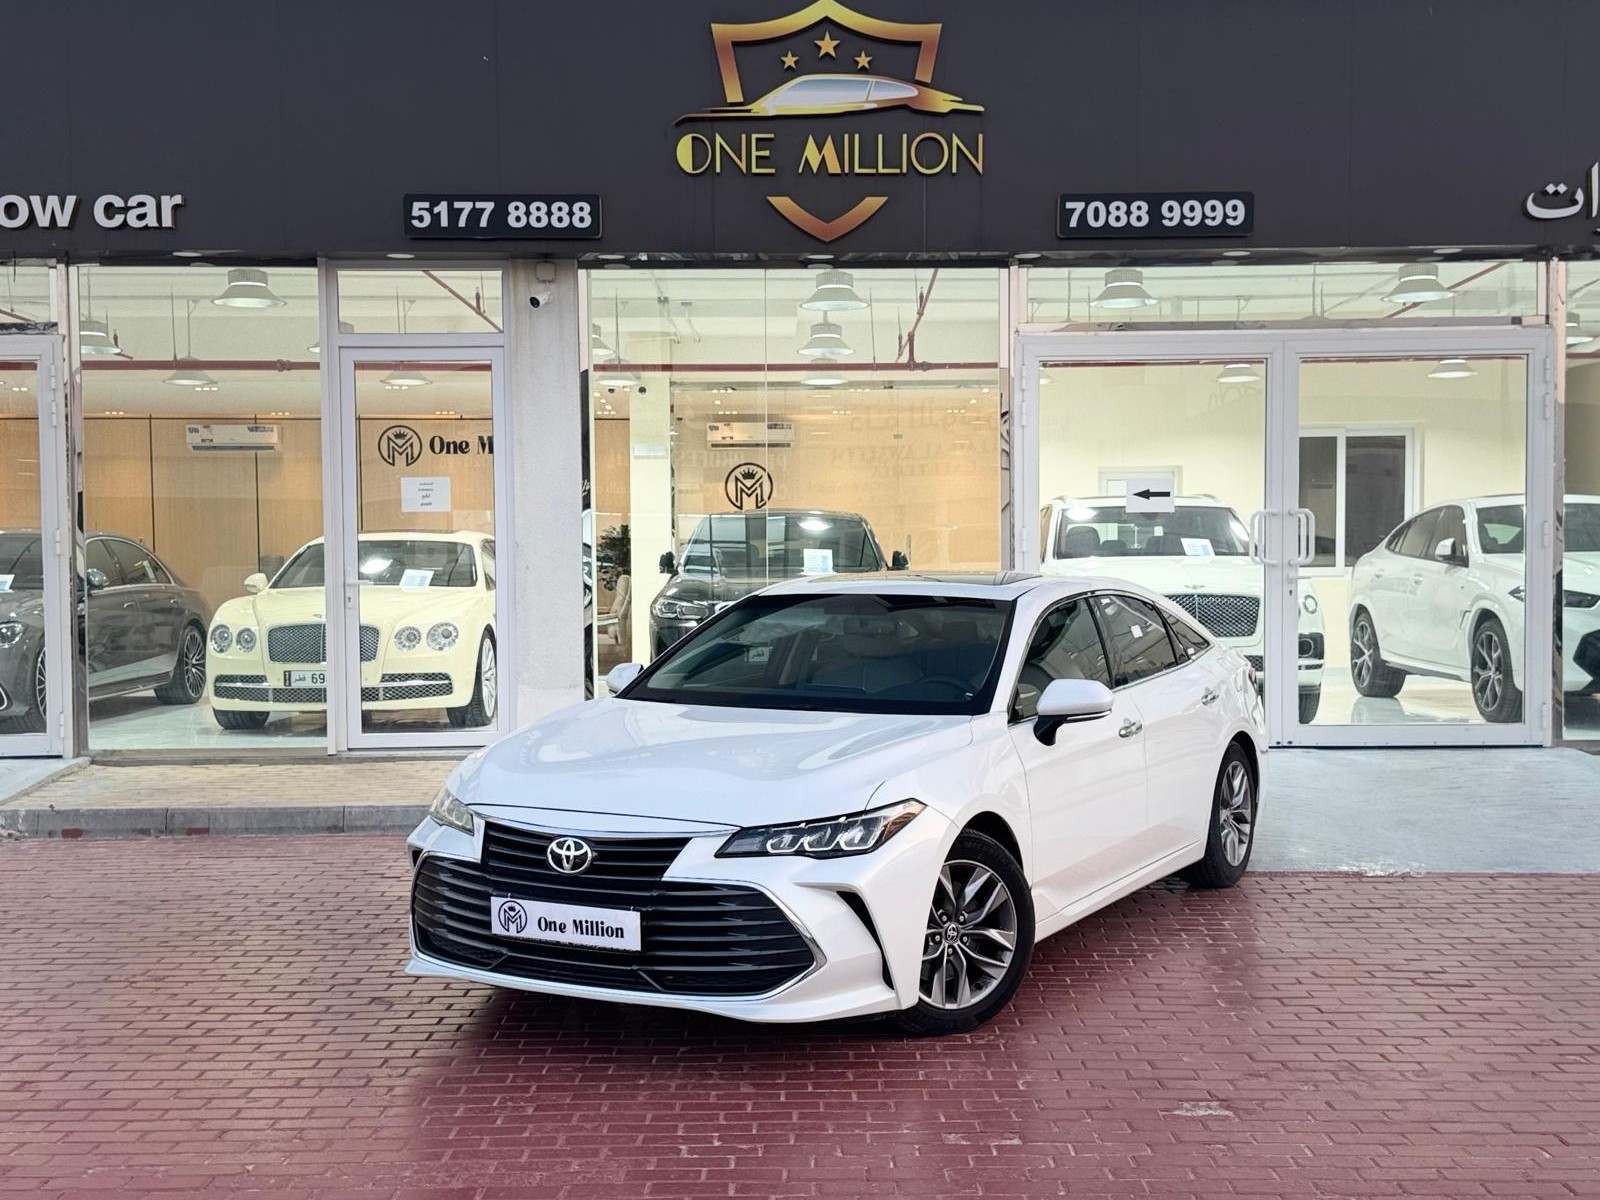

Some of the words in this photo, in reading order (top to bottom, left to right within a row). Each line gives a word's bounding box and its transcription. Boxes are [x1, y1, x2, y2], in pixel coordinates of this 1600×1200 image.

[676, 132, 775, 175] ONE
[798, 132, 985, 175] MILLION
[93, 194, 183, 229] car
[411, 200, 494, 229] 5177
[507, 200, 592, 229] 8888
[1065, 199, 1149, 229] 7088
[1161, 199, 1246, 228] 9999
[429, 435, 471, 455] One
[311, 673, 326, 685] 69
[537, 916, 567, 934] One
[572, 919, 625, 939] Million
